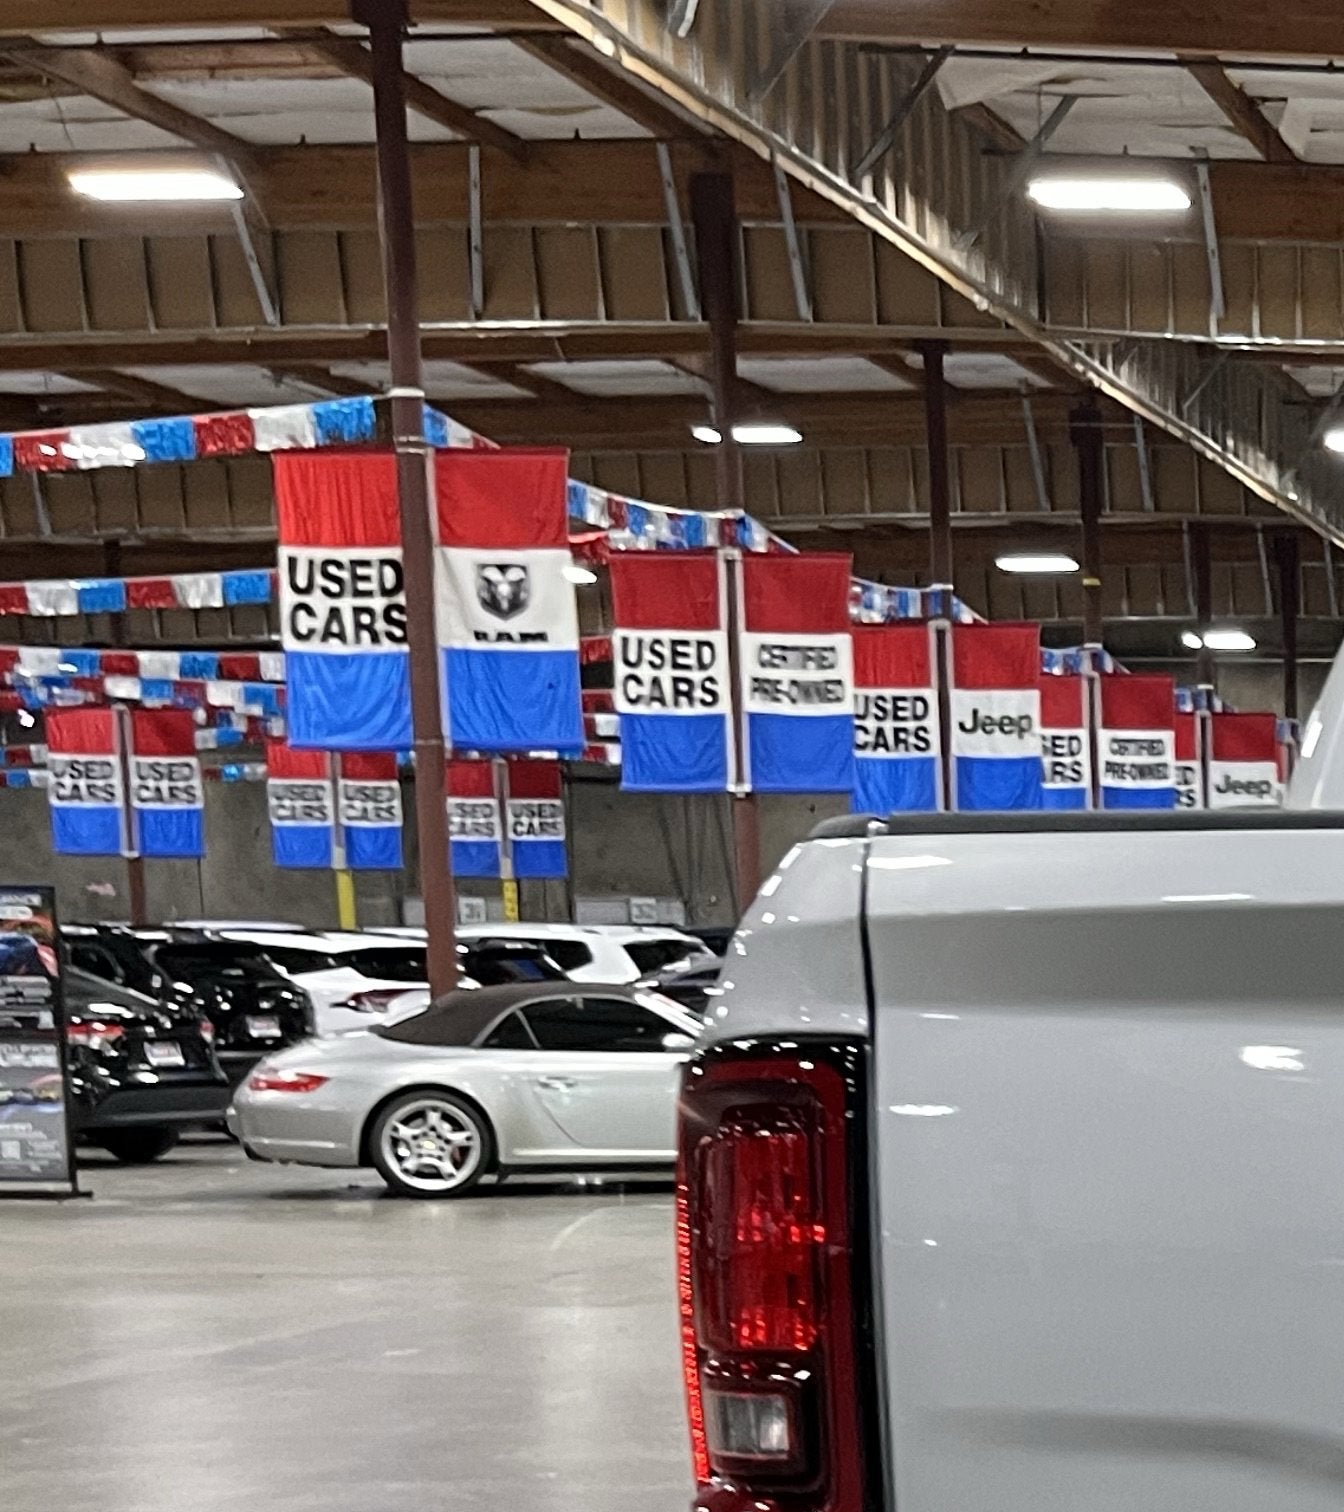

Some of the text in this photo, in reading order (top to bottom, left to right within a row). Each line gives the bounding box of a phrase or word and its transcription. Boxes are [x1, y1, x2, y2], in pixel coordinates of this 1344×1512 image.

[288, 556, 402, 598] USED
[291, 603, 407, 644] CARS
[473, 630, 548, 642] RAM
[621, 636, 716, 671] USED
[758, 644, 838, 670] CERTIFIED
[623, 674, 719, 708] CARS
[752, 677, 843, 704] PRE-OWNED
[854, 695, 929, 722] USED
[958, 708, 1033, 739] Jeep
[854, 725, 931, 752] CARS
[136, 761, 195, 782] USED
[1215, 774, 1273, 799] Jeep
